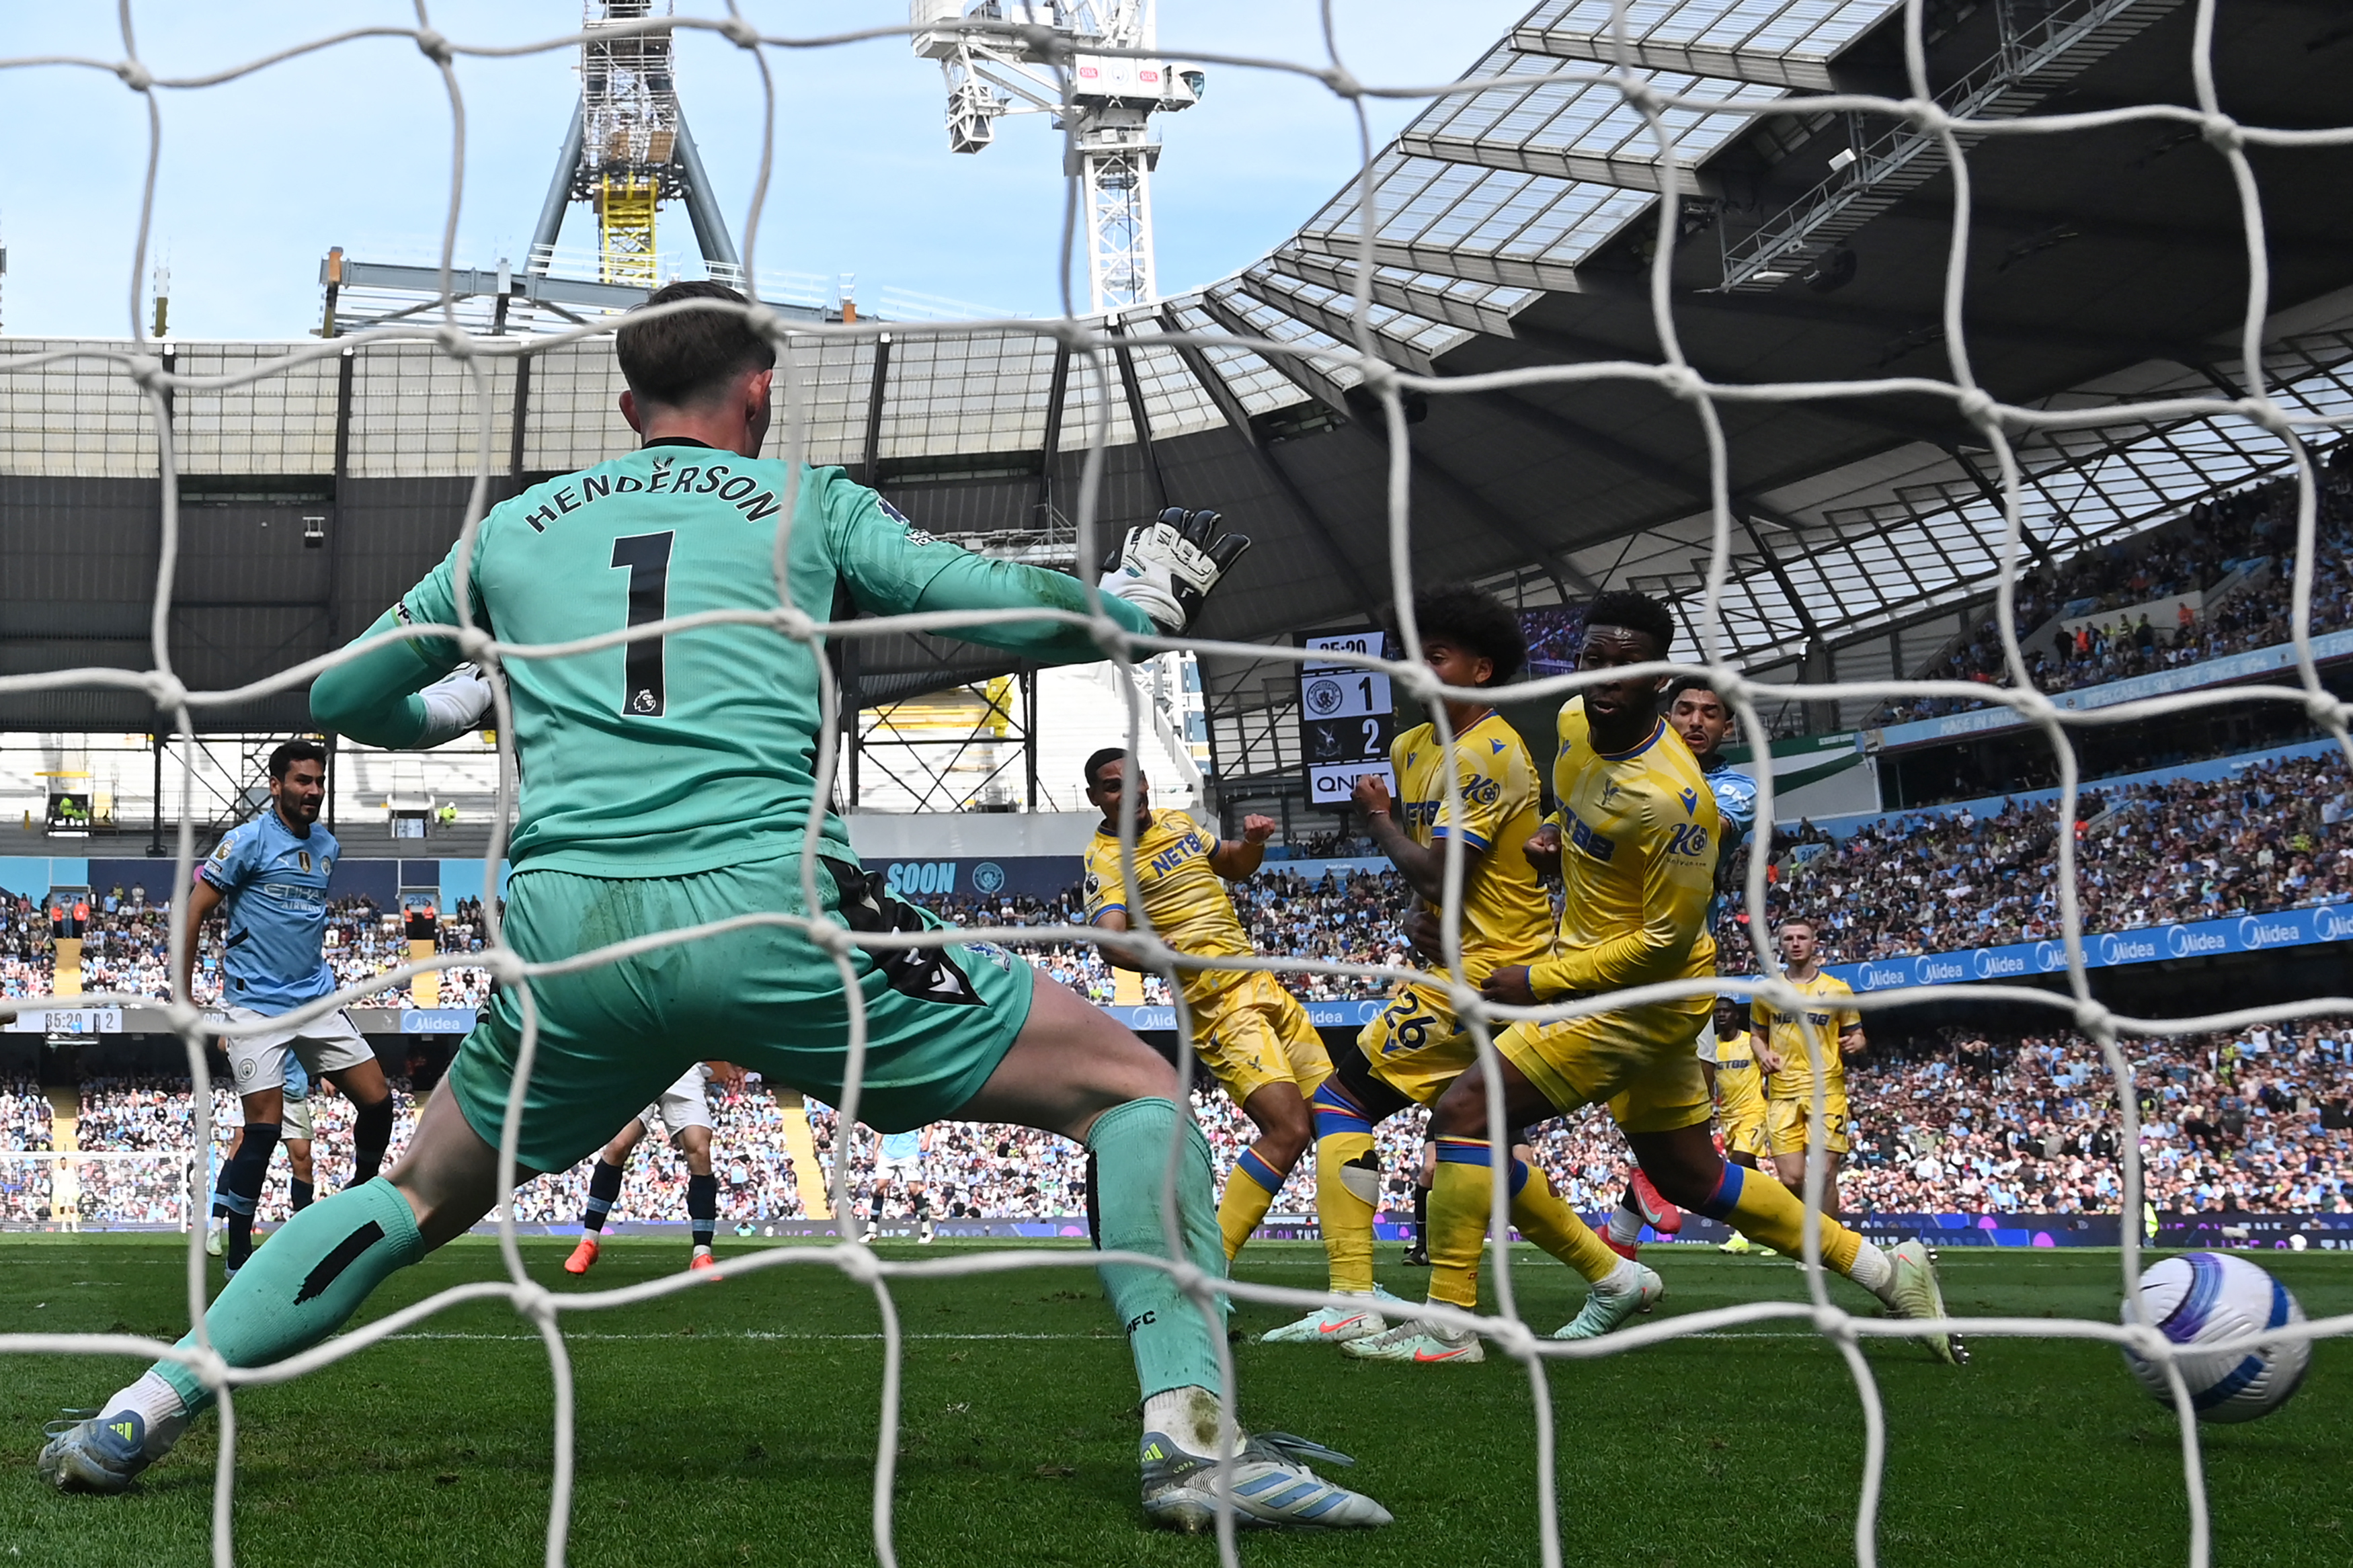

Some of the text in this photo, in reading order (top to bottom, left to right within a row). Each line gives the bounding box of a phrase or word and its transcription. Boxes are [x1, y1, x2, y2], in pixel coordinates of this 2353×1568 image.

[524, 465, 785, 534] HENDERSON
[609, 530, 676, 717] 1
[1359, 677, 1373, 710] 1
[1362, 718, 1380, 754] 2
[1150, 833, 1202, 878] NET8
[885, 862, 956, 894] SOON
[264, 883, 321, 901] ETIHA
[2180, 932, 2226, 952] Midea
[2250, 923, 2299, 945] Midea
[2110, 941, 2155, 961] Midea
[1923, 962, 1963, 981] Midea
[1985, 956, 2024, 974] Midea
[1868, 968, 1904, 987] Midea
[106, 1013, 113, 1029] 2
[414, 1016, 460, 1030] Midea
[1146, 1009, 1177, 1028] Mid
[1309, 1009, 1343, 1024] idea
[1383, 991, 1437, 1049] 26
